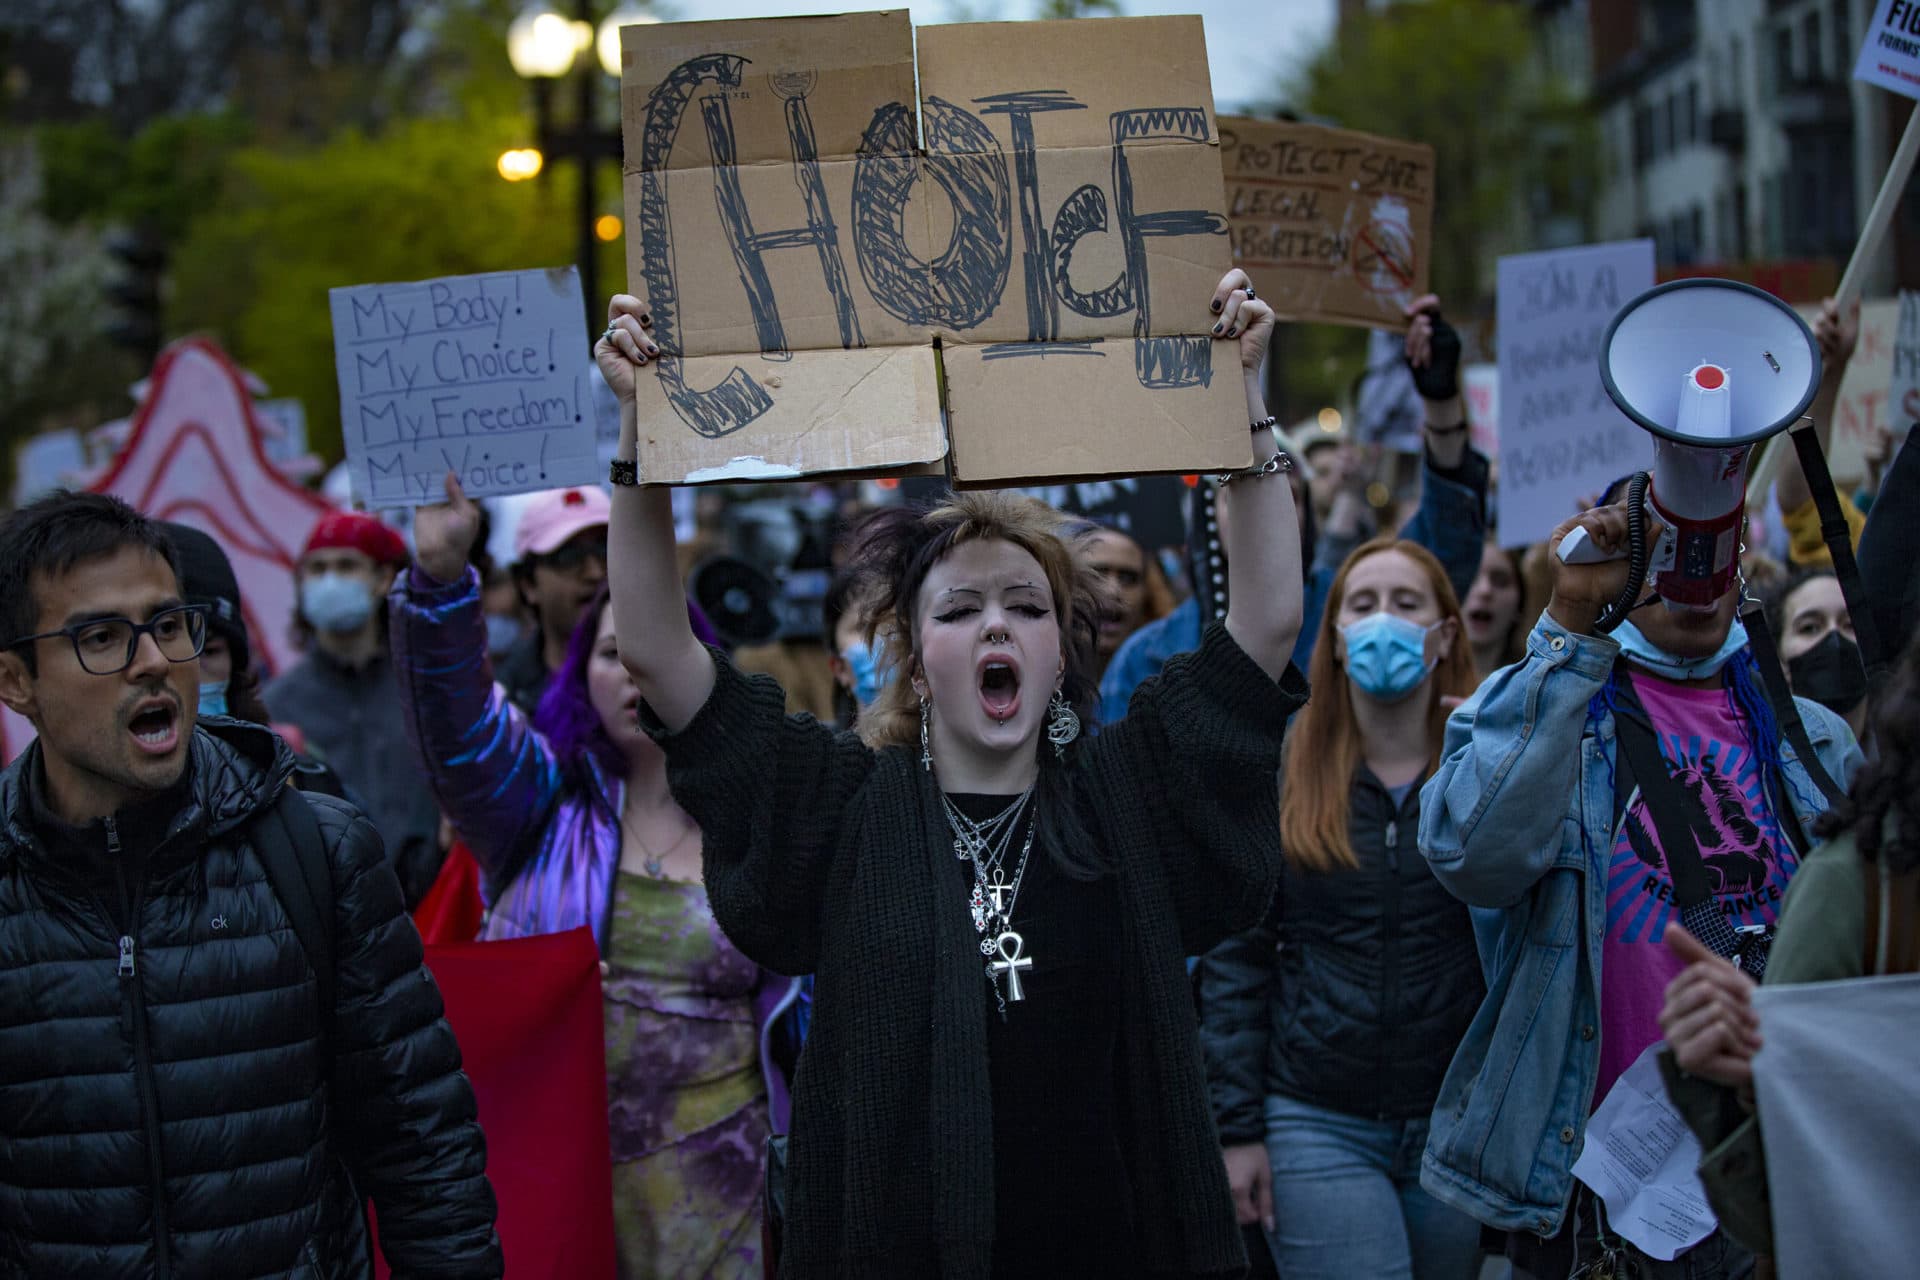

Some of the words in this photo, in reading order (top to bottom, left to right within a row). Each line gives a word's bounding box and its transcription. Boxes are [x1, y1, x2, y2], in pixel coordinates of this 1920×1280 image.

[641, 52, 1229, 439] CHOICE
[1229, 224, 1349, 261] BORTION
[351, 292, 416, 344] My
[429, 275, 523, 342] Body!
[356, 348, 419, 399] My
[432, 328, 556, 384] Choice!
[360, 400, 423, 451] My
[431, 376, 582, 439] Freedom!
[366, 452, 431, 503] My
[440, 433, 548, 488] Voice!
[211, 913, 229, 930] ck
